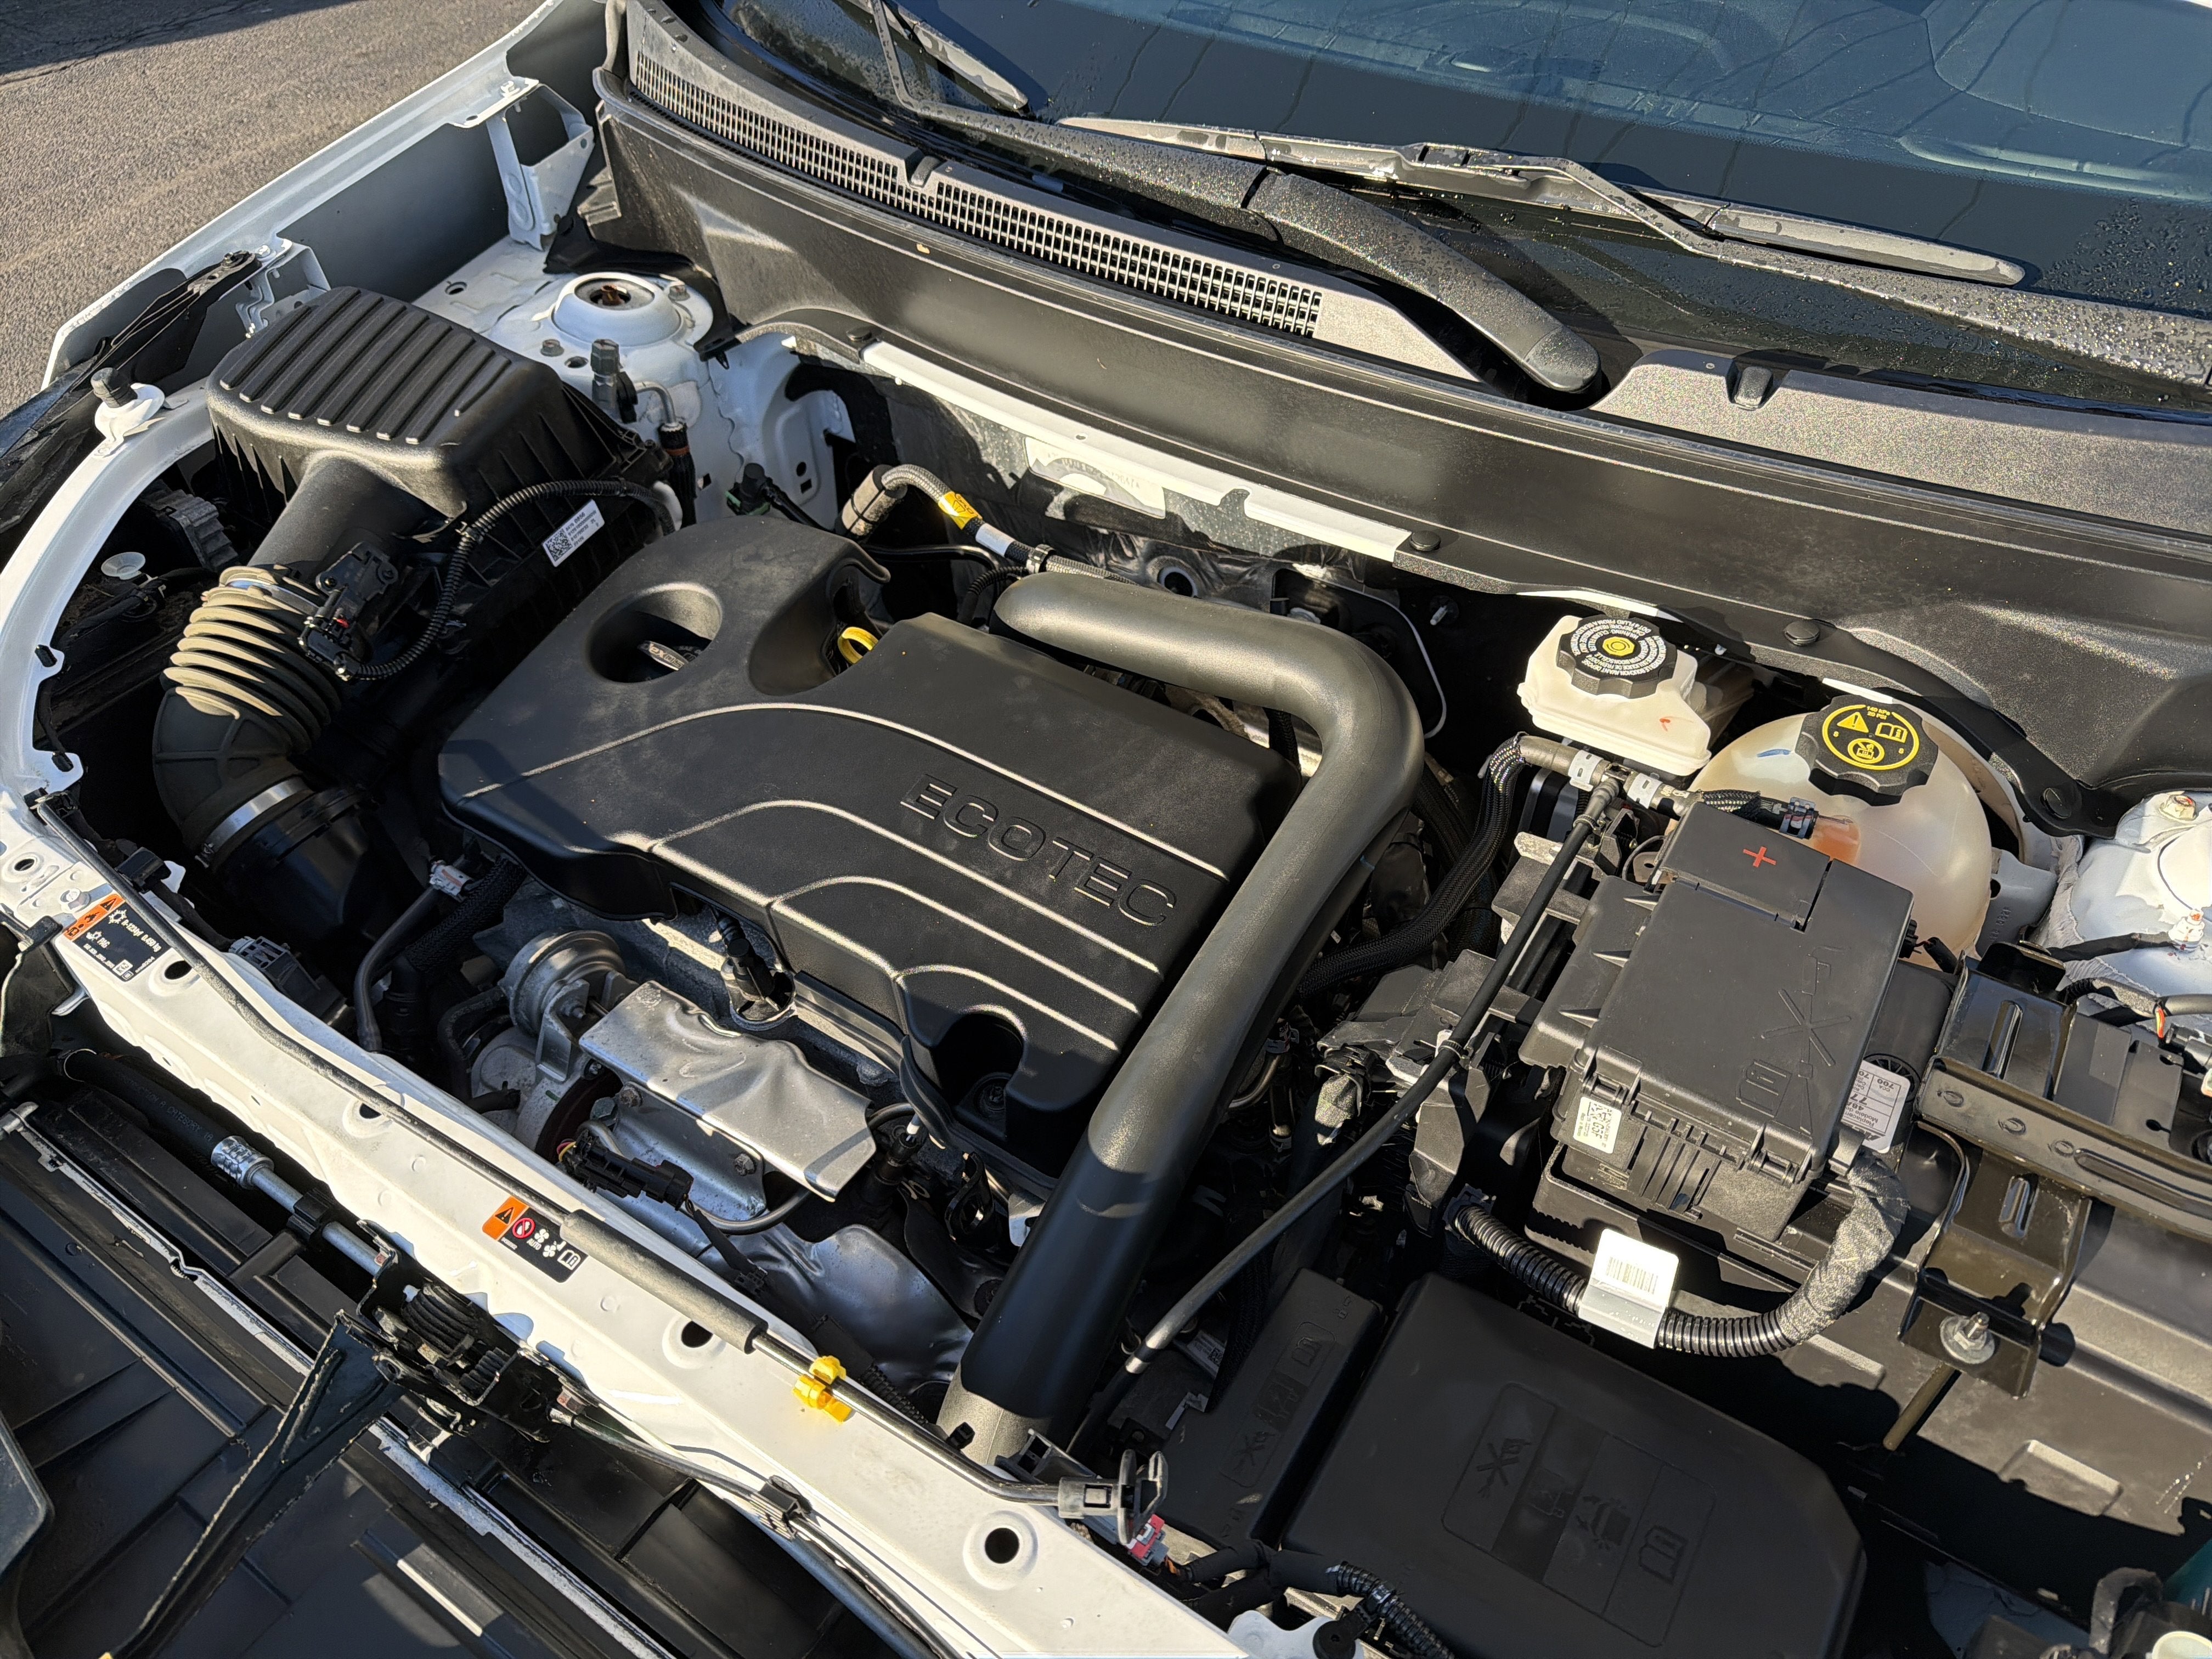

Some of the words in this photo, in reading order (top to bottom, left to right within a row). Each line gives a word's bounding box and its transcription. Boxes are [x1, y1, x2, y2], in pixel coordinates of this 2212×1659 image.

[1600, 667, 1621, 675] AVANT
[900, 774, 1177, 926] ECOTEC
[97, 938, 110, 948] PAG
[1877, 1079, 1894, 1090] 700
[527, 1238, 542, 1250] AUTO
